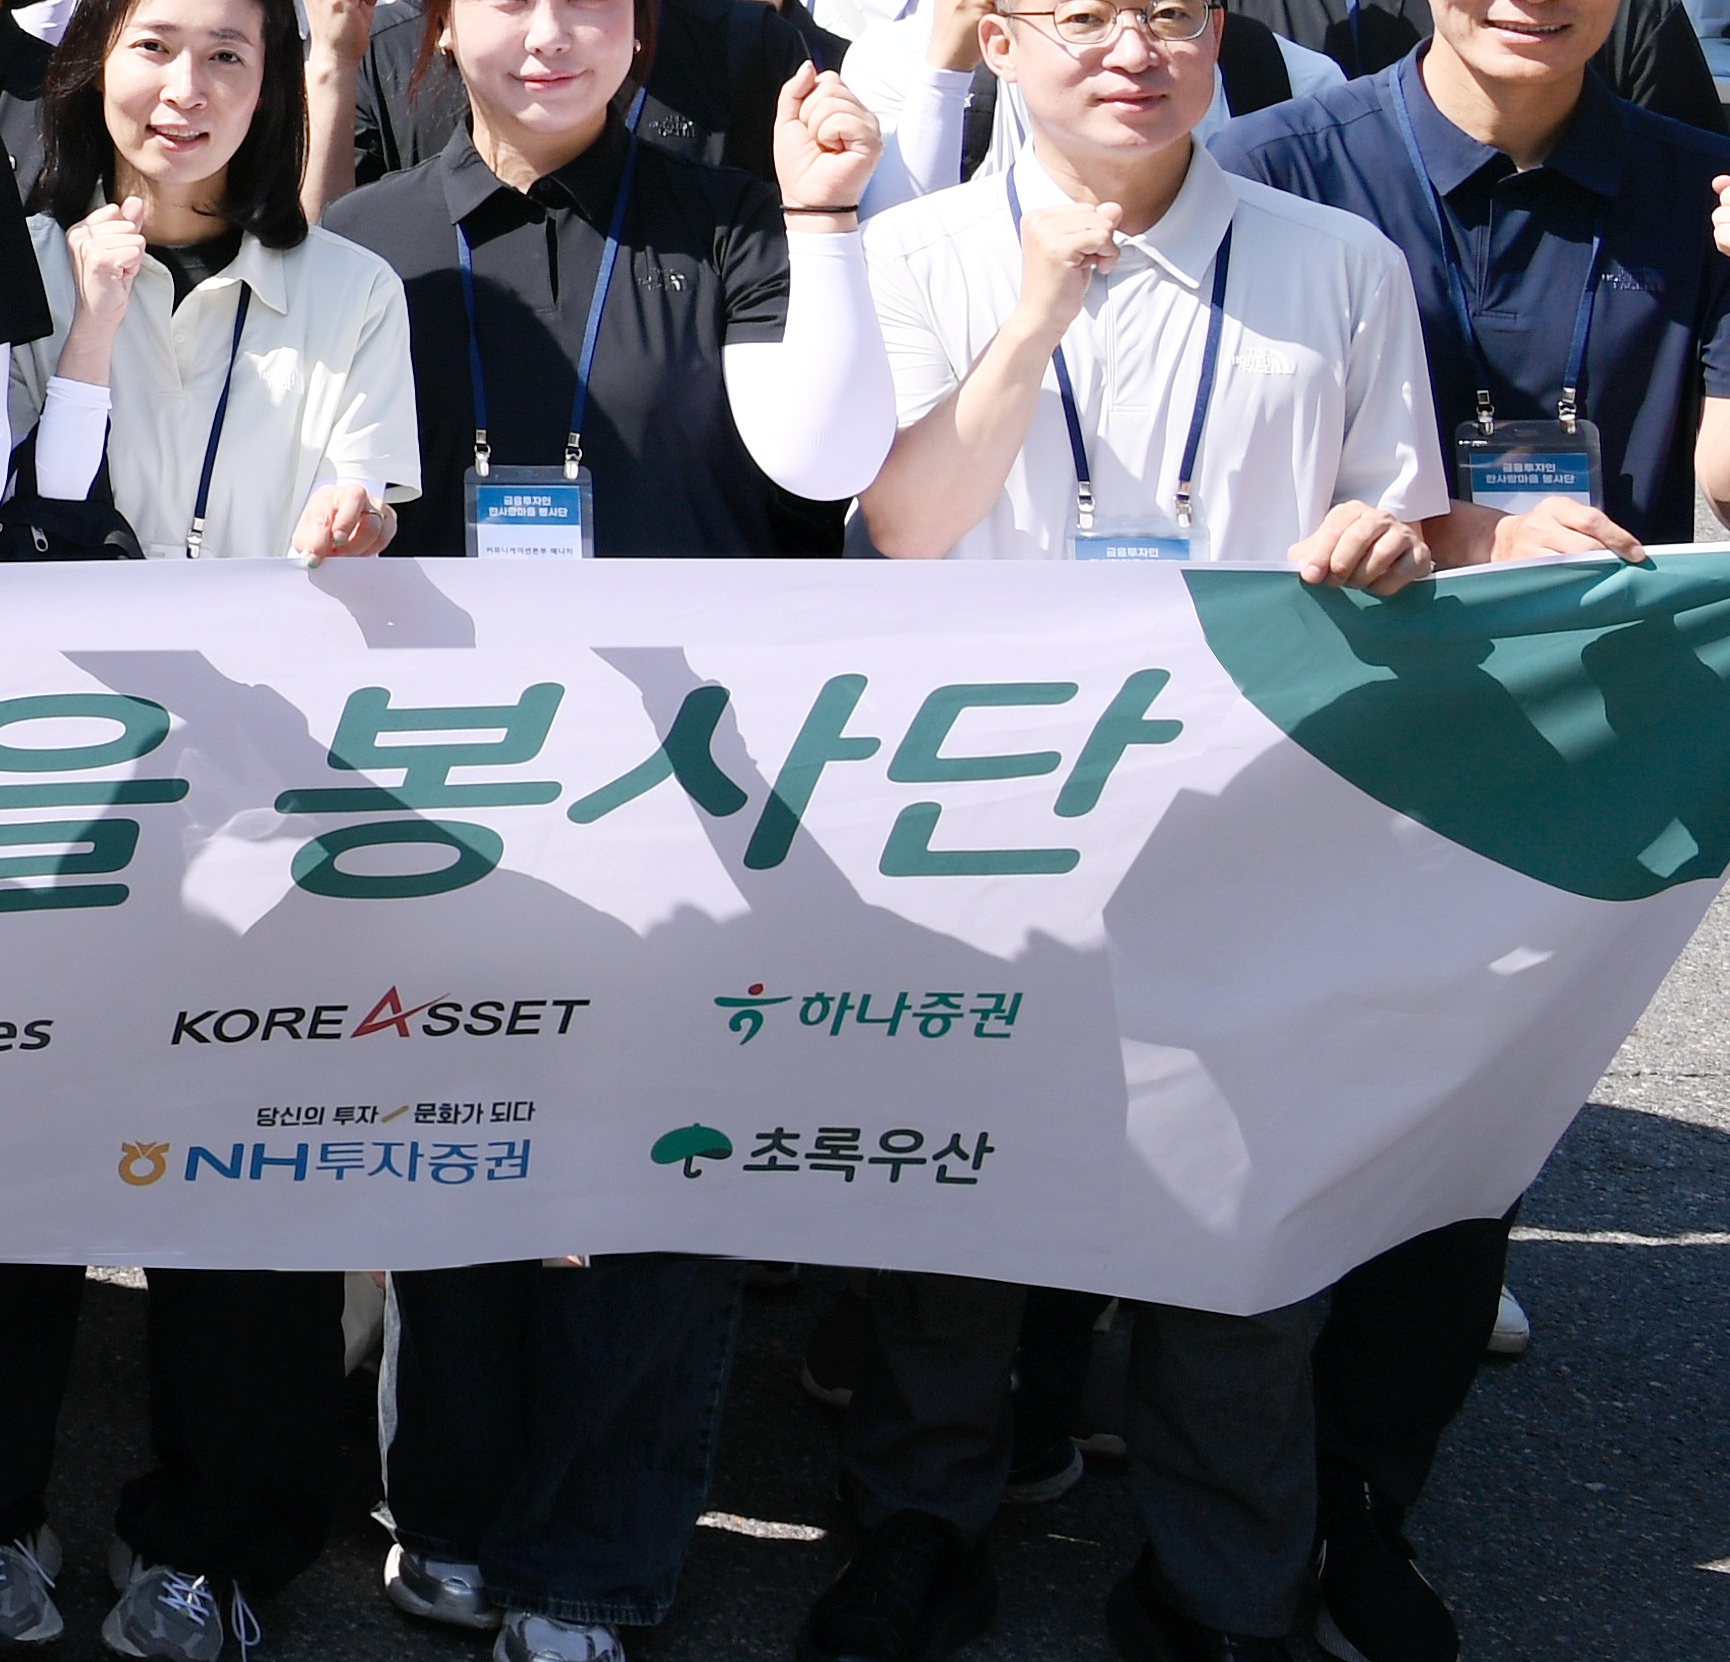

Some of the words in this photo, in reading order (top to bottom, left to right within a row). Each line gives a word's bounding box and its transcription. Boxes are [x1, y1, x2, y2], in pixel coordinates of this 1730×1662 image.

[1485, 473, 1539, 485] 한사랑마을
[1502, 462, 1556, 474] 금융투자인
[488, 506, 536, 517] 한사랑마을
[503, 495, 552, 506] 금융투자인
[1106, 546, 1159, 558] 금융투자인
[272, 665, 1187, 906] 봉사단
[170, 985, 591, 1046] KOREASSET
[799, 991, 1024, 1039] 하나증권
[256, 1104, 326, 1126] 당신의
[332, 1105, 379, 1126] 투자
[413, 1102, 484, 1125] 문화가
[489, 1101, 536, 1124] 되다
[184, 1139, 531, 1185] NH투자증권
[742, 1126, 995, 1185] 초록우산
